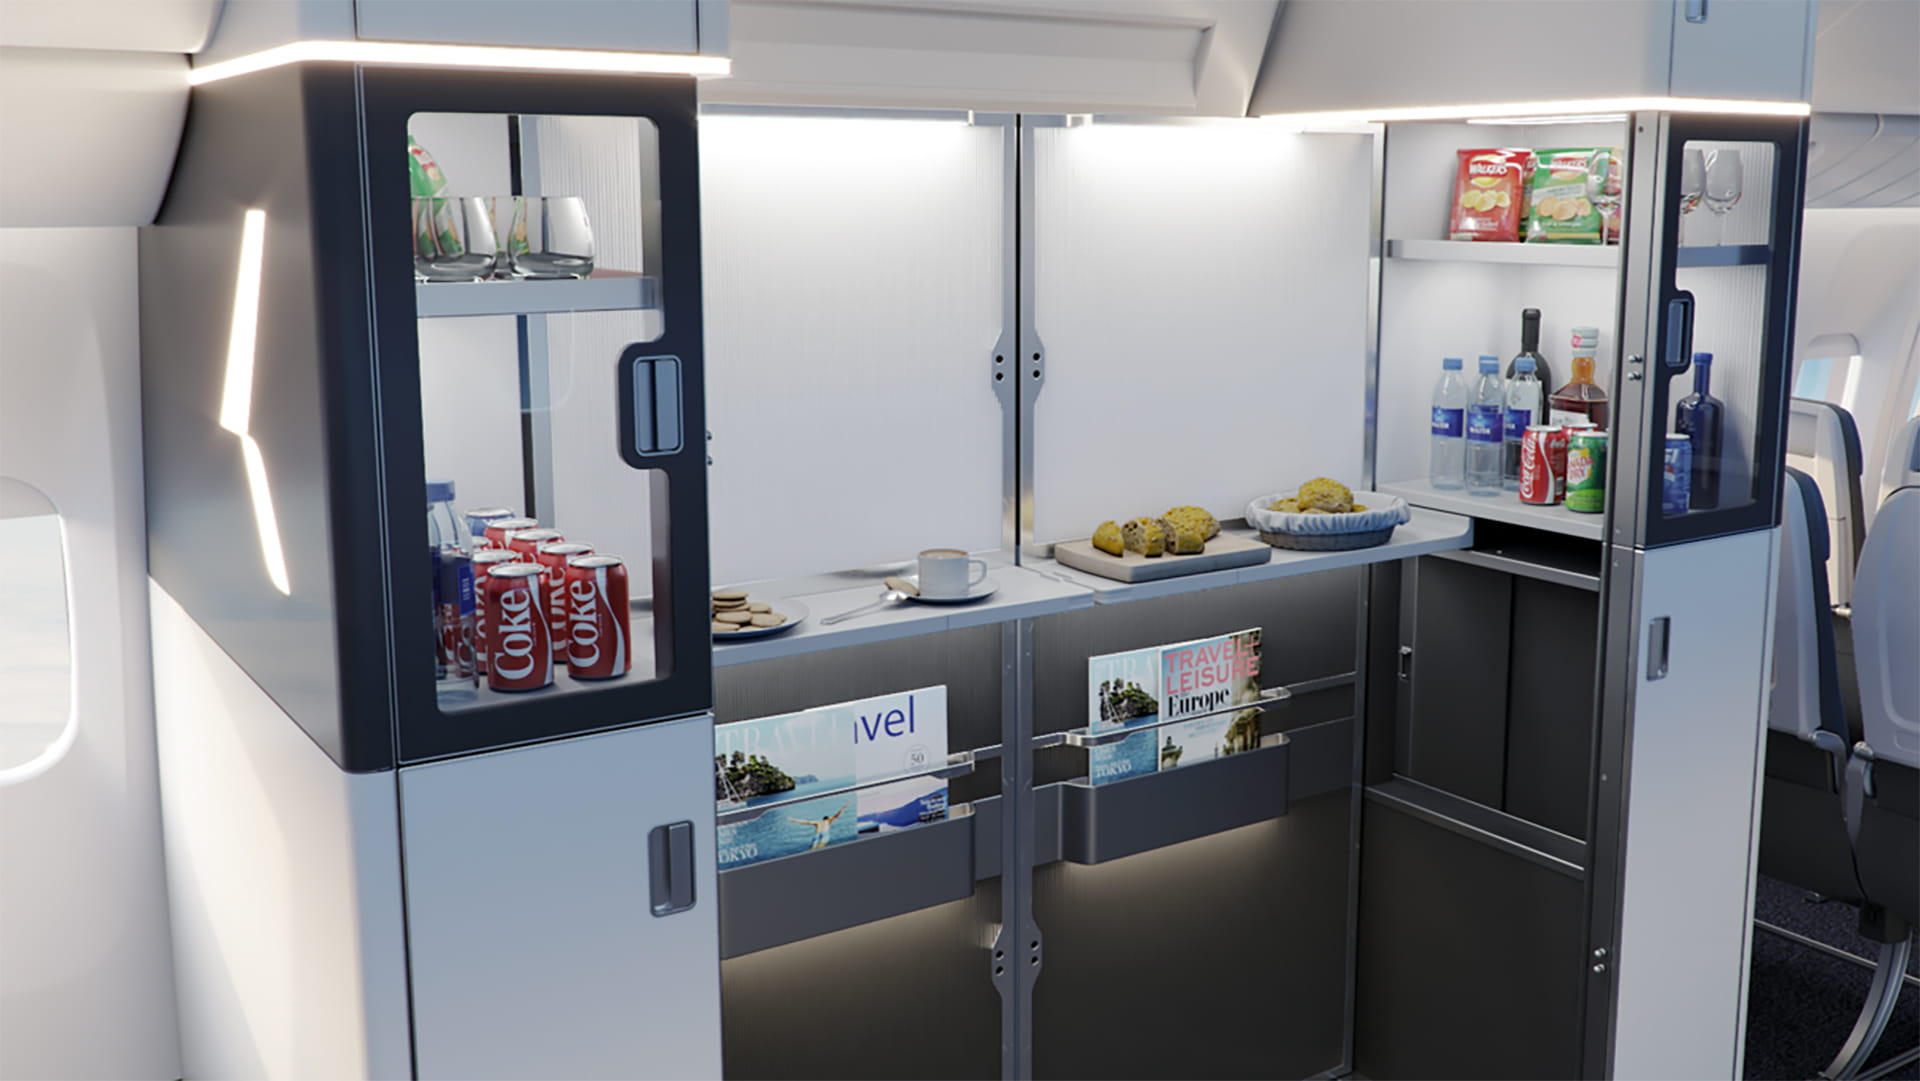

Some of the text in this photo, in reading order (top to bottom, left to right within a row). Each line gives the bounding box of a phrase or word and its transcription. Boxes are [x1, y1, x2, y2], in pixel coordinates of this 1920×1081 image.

[494, 588, 535, 680] Coke
[568, 579, 601, 669] Coke
[1166, 655, 1260, 696] LEISURE
[853, 694, 915, 744] vel
[1167, 687, 1230, 717] Europe
[910, 751, 926, 764] 50
